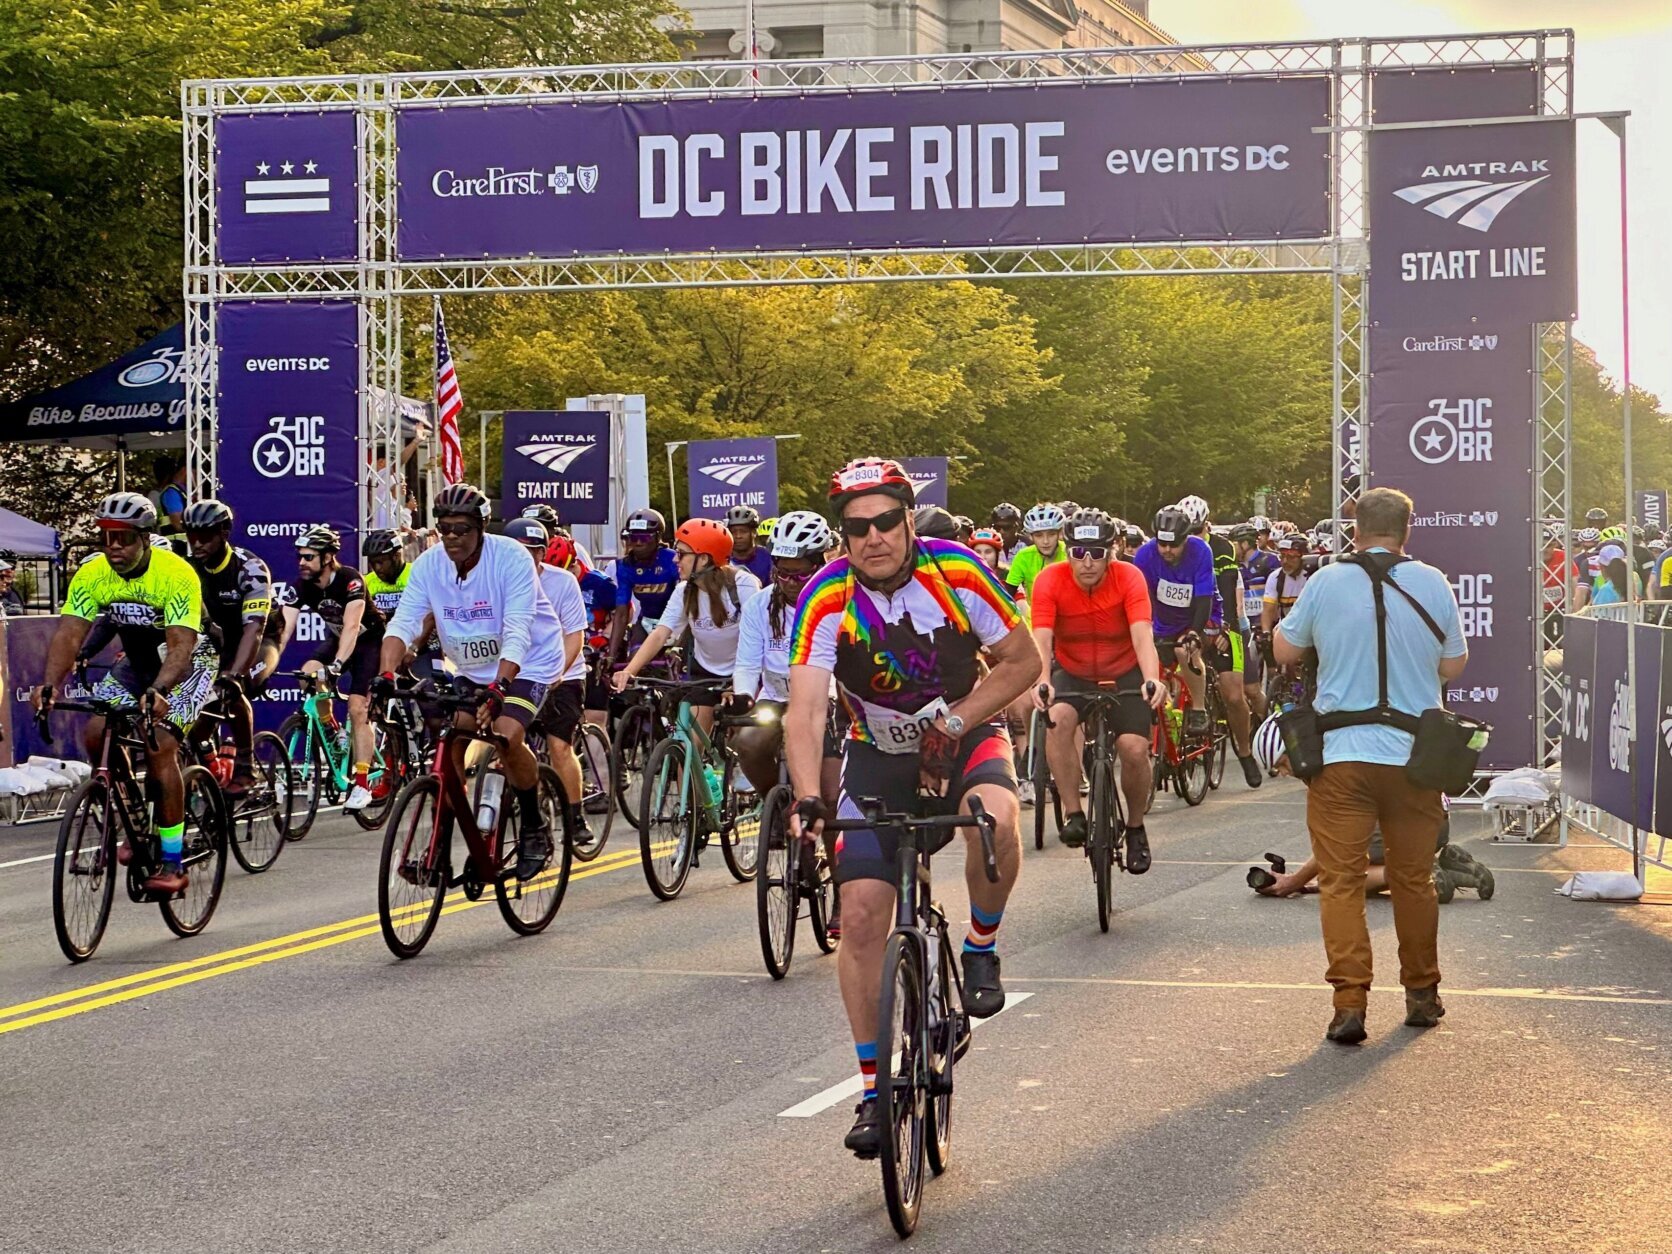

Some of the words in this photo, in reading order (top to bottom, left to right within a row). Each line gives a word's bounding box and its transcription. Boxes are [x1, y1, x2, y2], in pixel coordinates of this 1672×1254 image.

[1246, 144, 1290, 171] DC
[1421, 160, 1549, 177] AMTRAK
[639, 133, 724, 218] DC
[741, 127, 895, 216] BIKE
[910, 121, 1065, 210] RIDE
[432, 167, 543, 197] CareFirst
[1401, 249, 1480, 281] START
[1490, 247, 1546, 277] LINE
[1403, 336, 1466, 352] CareFirst
[309, 358, 330, 370] DC
[27, 406, 75, 426] Bike
[78, 403, 163, 423] Because
[1459, 398, 1492, 428] DC
[295, 416, 324, 445] DC
[530, 434, 597, 442] AMTRAK
[1459, 431, 1492, 461] BR
[295, 447, 324, 475] BR
[710, 455, 765, 464] AMTRAK
[855, 469, 879, 480] 8304
[517, 482, 559, 499] START
[563, 482, 594, 499] LINE
[702, 494, 737, 508] START
[740, 491, 765, 505] LINE
[1165, 585, 1190, 601] 6254
[1459, 574, 1493, 605] DC
[296, 612, 325, 641] BR
[1461, 607, 1493, 637] BR
[461, 639, 499, 659] 7860
[769, 638, 782, 649] THE
